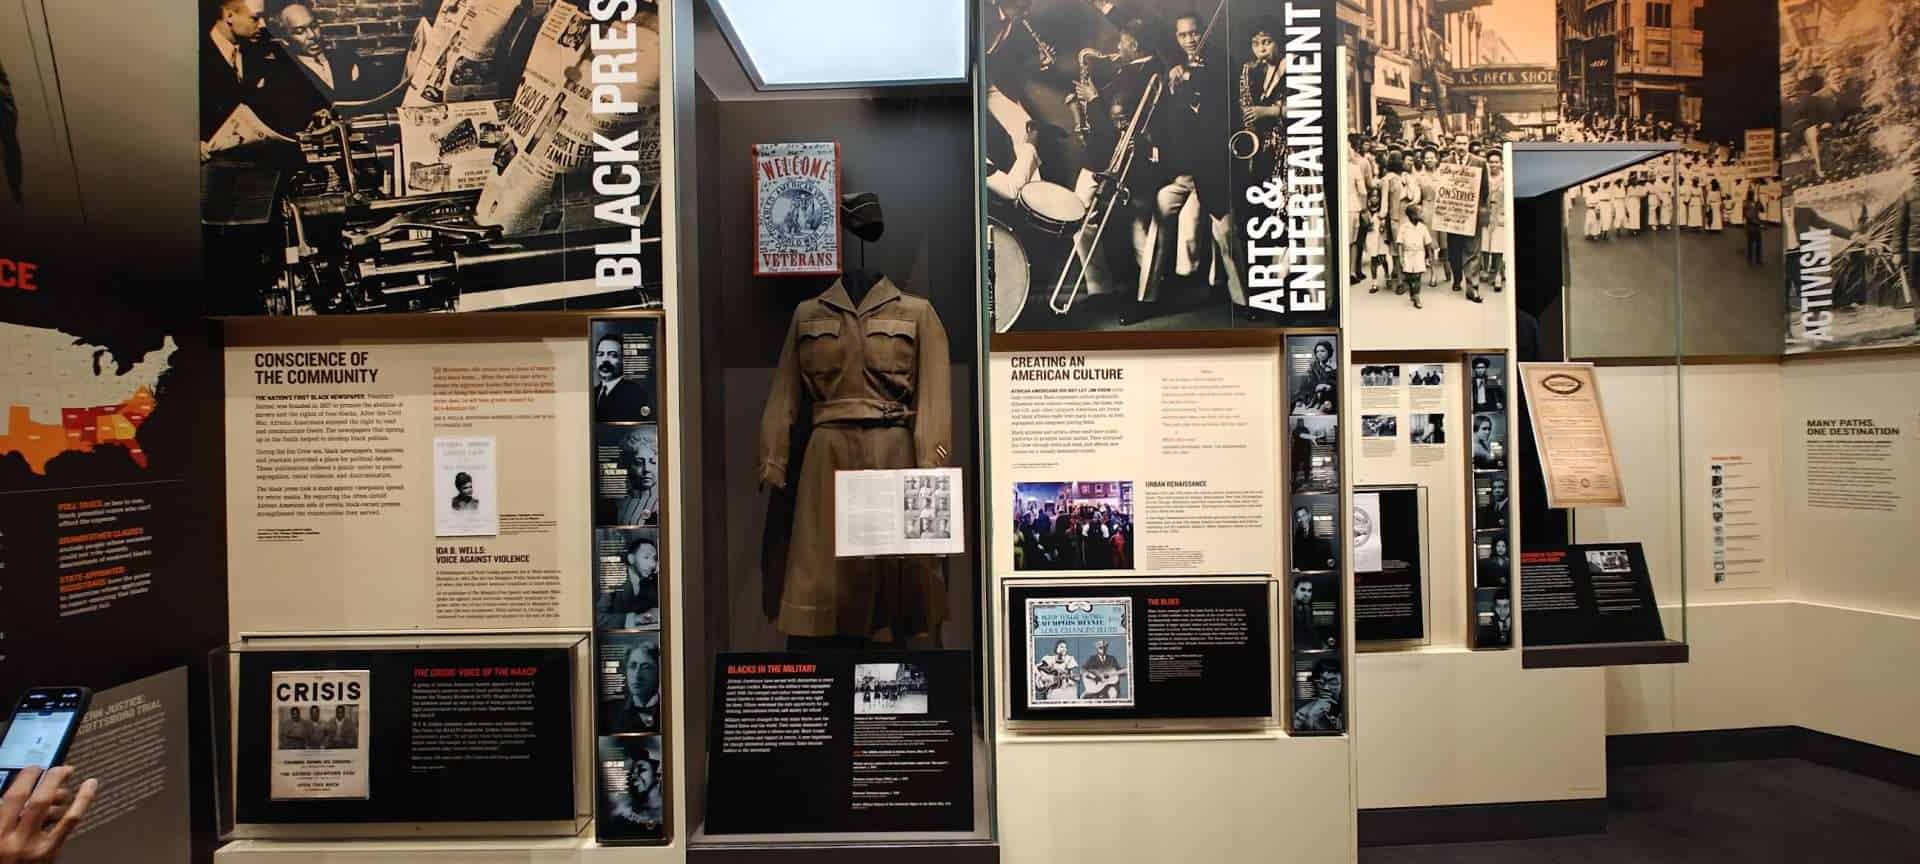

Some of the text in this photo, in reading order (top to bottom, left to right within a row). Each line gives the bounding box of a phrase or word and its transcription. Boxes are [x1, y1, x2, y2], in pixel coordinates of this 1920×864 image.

[590, 0, 641, 114] PRES
[1285, 2, 1327, 312] ENTERTAINMENT
[761, 155, 832, 181] WELCOME
[592, 129, 642, 289] BLACK
[1246, 178, 1286, 314] ARTS &
[762, 252, 833, 268] VETERANS
[1800, 226, 1833, 342] ACTIVISM
[255, 351, 369, 368] CONSCIENCE OF
[1011, 356, 1085, 369] CREATING AN
[255, 368, 378, 385] THE COMMUNITY
[1011, 368, 1124, 381] AMERICAN CULTURE
[1807, 427, 1900, 436] ONE DESTINATION
[1145, 480, 1207, 488] URBAN RENAISSANCE
[436, 554, 530, 564] VOICE AGAINST VIOLENCE
[728, 664, 816, 674] BLACKS IN THE MILITARY
[276, 682, 361, 702] CRISIS
